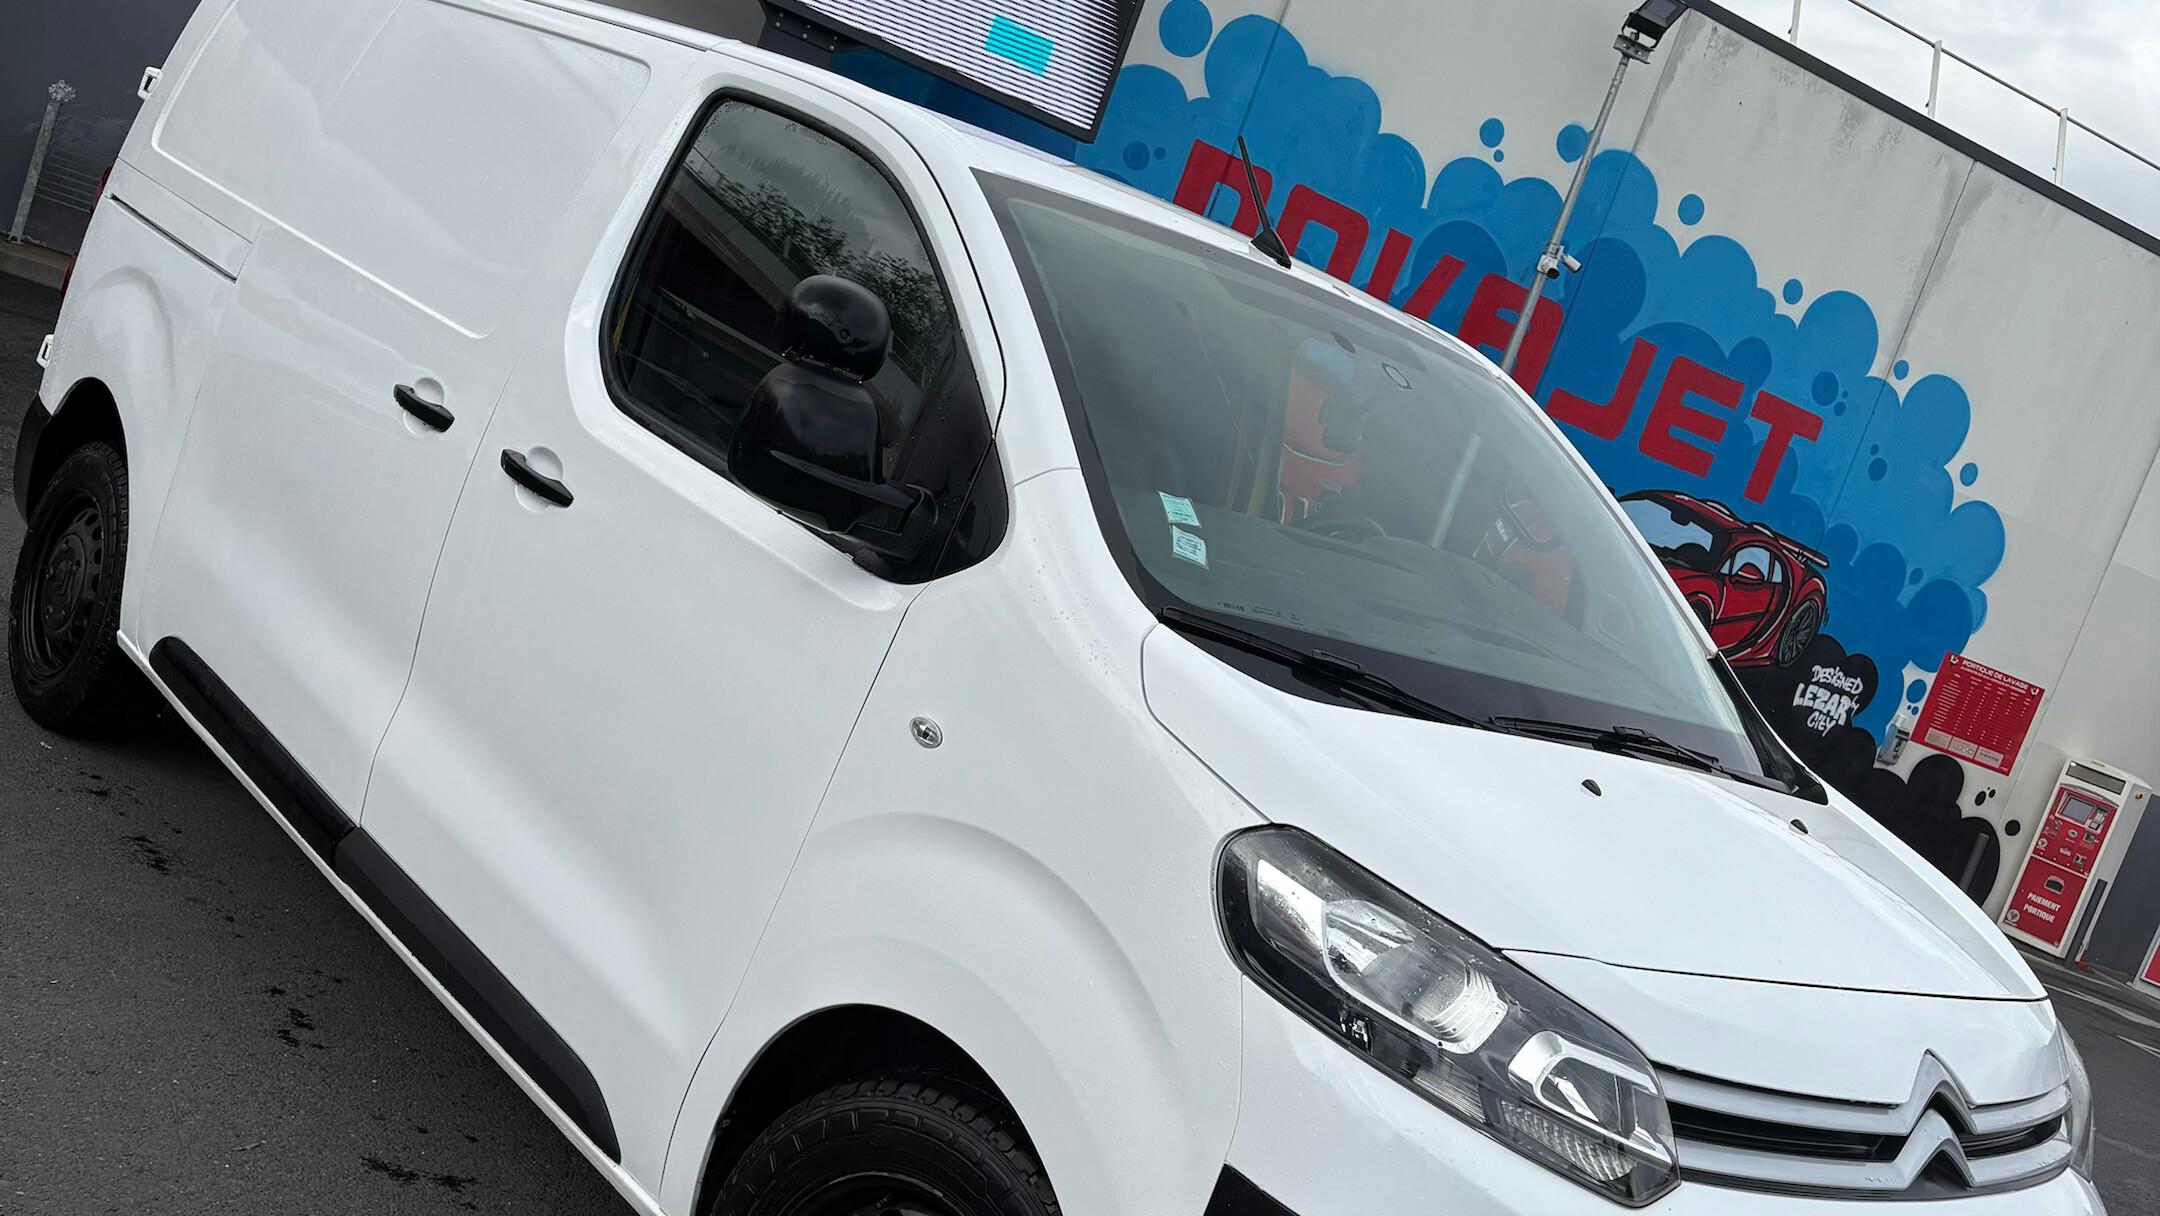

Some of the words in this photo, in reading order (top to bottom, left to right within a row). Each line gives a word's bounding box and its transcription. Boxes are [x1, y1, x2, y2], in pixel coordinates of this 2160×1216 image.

[1962, 659, 1993, 678] PORTIQUE
[1993, 670, 2004, 681] DE
[2003, 673, 2029, 690] LAVAGE
[2027, 892, 2061, 912] PAIEMENT
[2023, 903, 2056, 924] PORTIQUE
